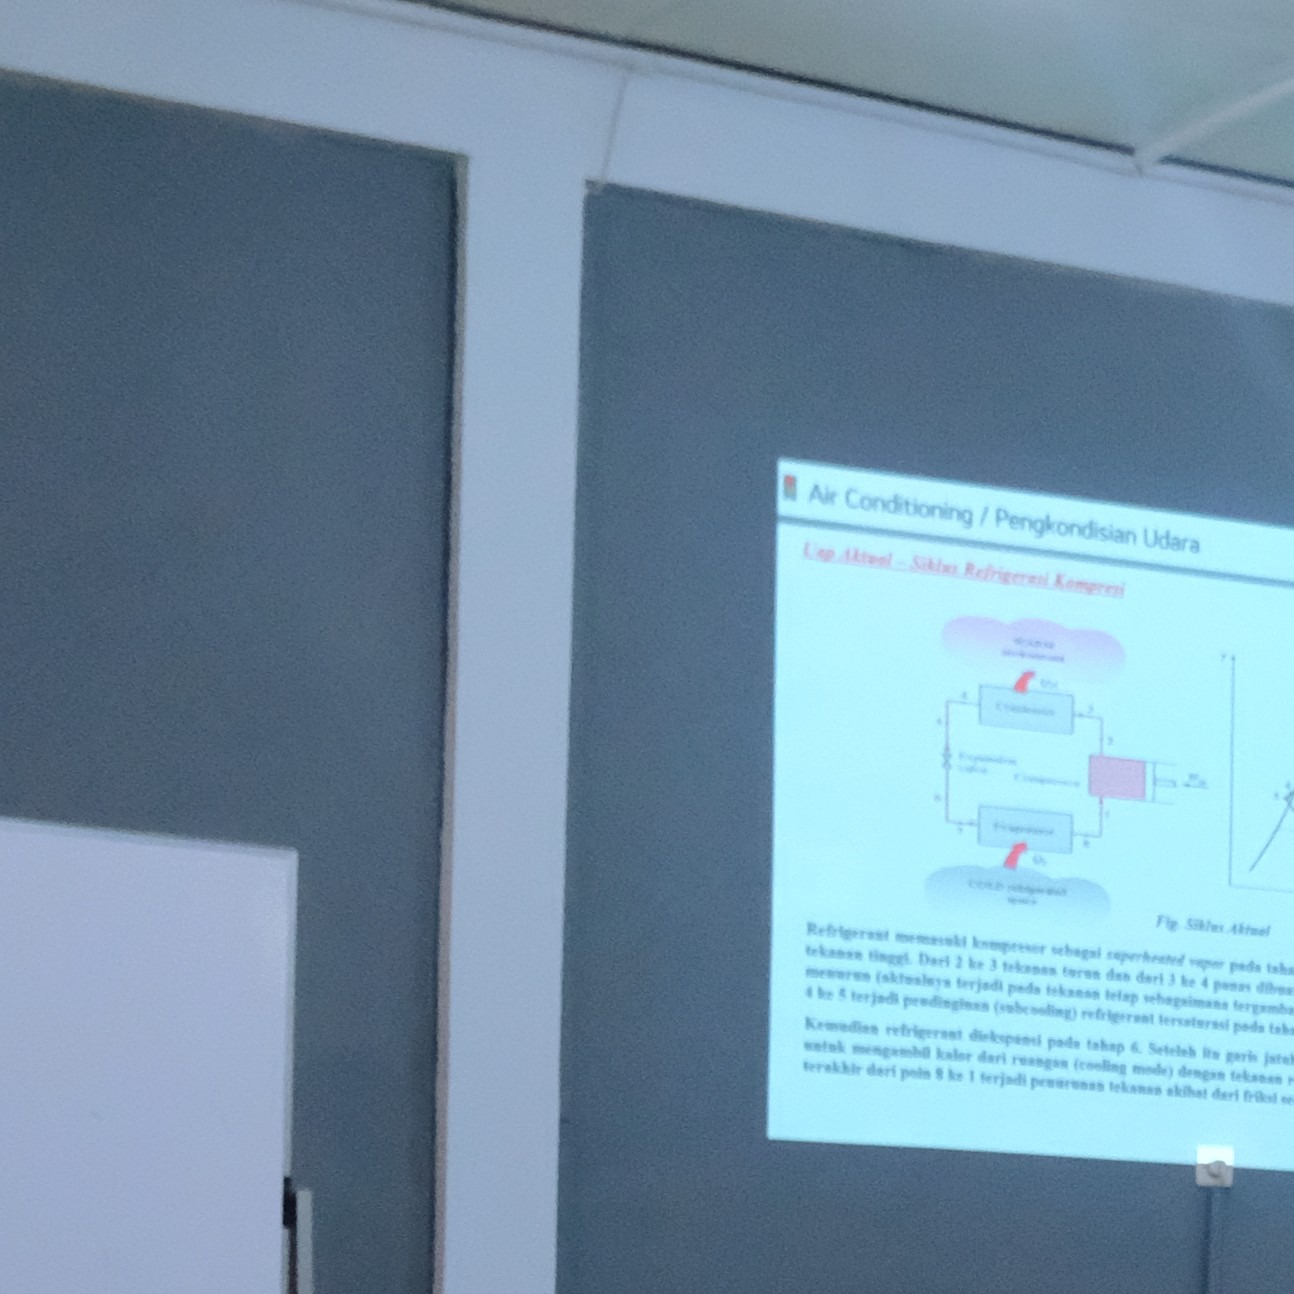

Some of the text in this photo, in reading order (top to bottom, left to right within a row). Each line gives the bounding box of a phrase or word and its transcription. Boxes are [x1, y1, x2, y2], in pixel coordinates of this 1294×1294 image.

[808, 483, 1201, 553] Air Conditioning / Pengkondisian Udara
[804, 541, 835, 561] Uap
[841, 545, 893, 566] Aktual
[909, 553, 958, 575] Siklus
[963, 561, 1048, 589] Refrigerasi
[1053, 573, 1125, 599] Kompresi
[805, 921, 889, 940] Refrigerant
[894, 932, 967, 947] memasuki
[1050, 943, 1102, 959] sebagai
[1188, 957, 1224, 970] vapor
[1228, 959, 1261, 973] pada
[1155, 914, 1271, 936] Fig. Siklus Aktual
[804, 944, 863, 960] tekanan
[867, 950, 910, 965] tinggi.
[918, 952, 950, 967] Dari
[955, 955, 963, 969] 2
[967, 956, 984, 969] ke
[990, 958, 997, 971] 3
[1001, 961, 1057, 975] tekanan
[1061, 966, 1101, 979] turun
[1105, 968, 1131, 981] dan
[1135, 970, 1164, 984] dari
[1168, 972, 1175, 985] 3
[1179, 974, 1195, 987] ke
[1200, 976, 1208, 988] 4
[1212, 980, 1251, 992] panas
[804, 967, 871, 981] menurun
[955, 977, 1003, 991] terjadi
[1007, 982, 1041, 994] pada
[1045, 985, 1100, 999] tekanan
[1104, 989, 1139, 1004] tetap
[1143, 993, 1228, 1009] sebagaimana
[804, 985, 813, 998] 4
[816, 986, 833, 1000] ke
[838, 987, 846, 999] 5
[850, 991, 899, 1006] terjadi
[902, 995, 990, 1012] pendinginan
[992, 1001, 1077, 1021] (subcooling)
[1080, 1008, 1154, 1024] refrigerant
[1232, 1021, 1265, 1034] pada
[802, 1040, 845, 1052] untuk
[935, 1048, 972, 1061] kalor
[977, 1050, 1006, 1063] dari
[1011, 1056, 1068, 1069] ruangan
[1072, 1058, 1126, 1075] (cooling
[1131, 1063, 1173, 1076] mode)
[1177, 1065, 1225, 1081] dengan
[1230, 1070, 1282, 1084] tekanan
[803, 1016, 879, 1034] Kemudian
[885, 1023, 963, 1039] refrigerant
[1046, 1035, 1080, 1049] pada
[1086, 1038, 1125, 1054] tahap
[1147, 1041, 1196, 1057] Setelah
[1201, 1046, 1220, 1059] itu
[1224, 1049, 1258, 1062] garis
[801, 1060, 862, 1075] terakhir
[865, 1063, 896, 1077] dari
[934, 1067, 944, 1080] 8
[946, 1068, 963, 1081] ke
[968, 1069, 975, 1082] 1
[979, 1072, 1027, 1087] terjadi
[1029, 1077, 1105, 1092] penurunan
[1108, 1081, 1162, 1095] tekanan
[1165, 1085, 1207, 1099] akibat
[1211, 1088, 1239, 1101] dari
